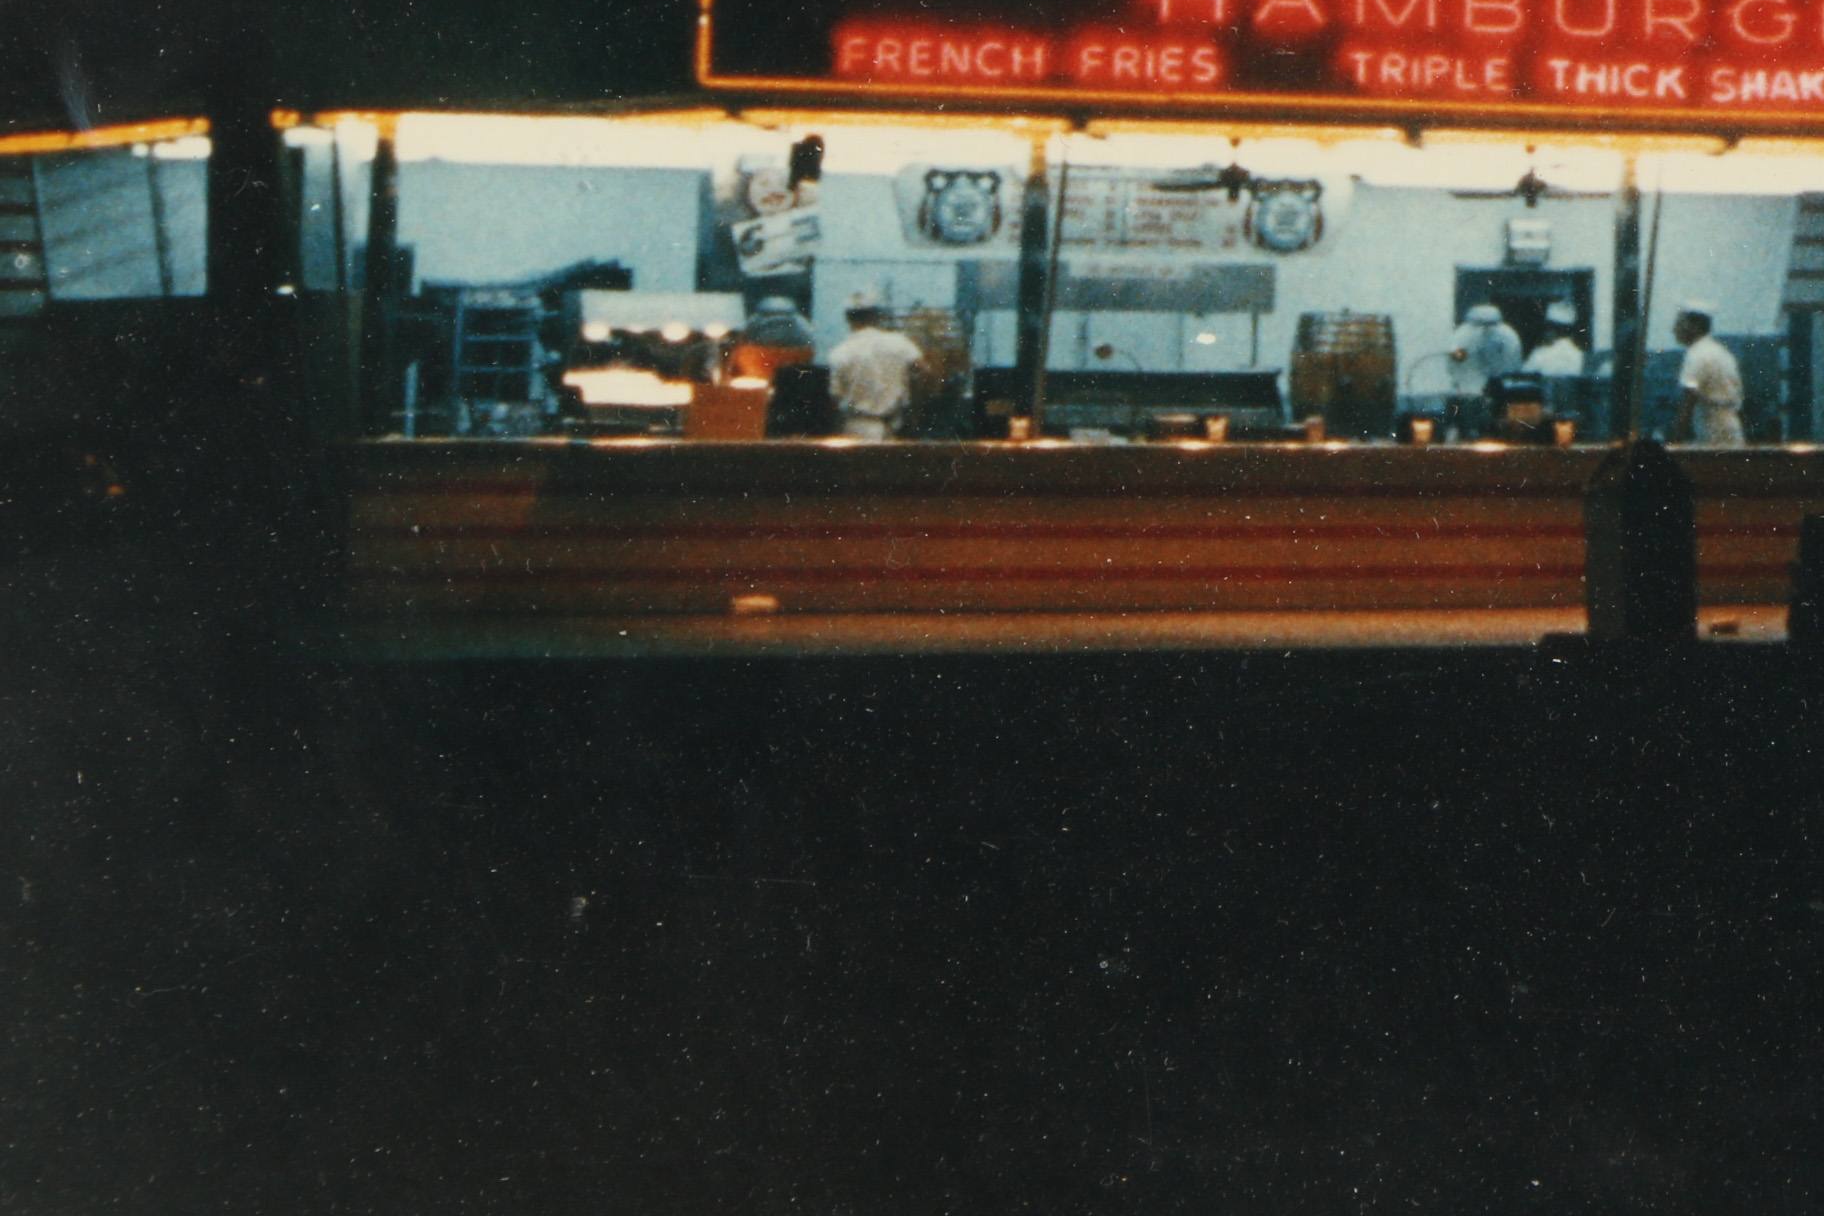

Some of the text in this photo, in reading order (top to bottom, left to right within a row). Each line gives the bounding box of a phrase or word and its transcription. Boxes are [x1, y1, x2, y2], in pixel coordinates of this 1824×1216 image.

[838, 37, 1046, 80] FRENCH
[1079, 45, 1220, 84] FRIES
[1351, 50, 1510, 92] TRIPLE
[1547, 57, 1687, 100] THICK
